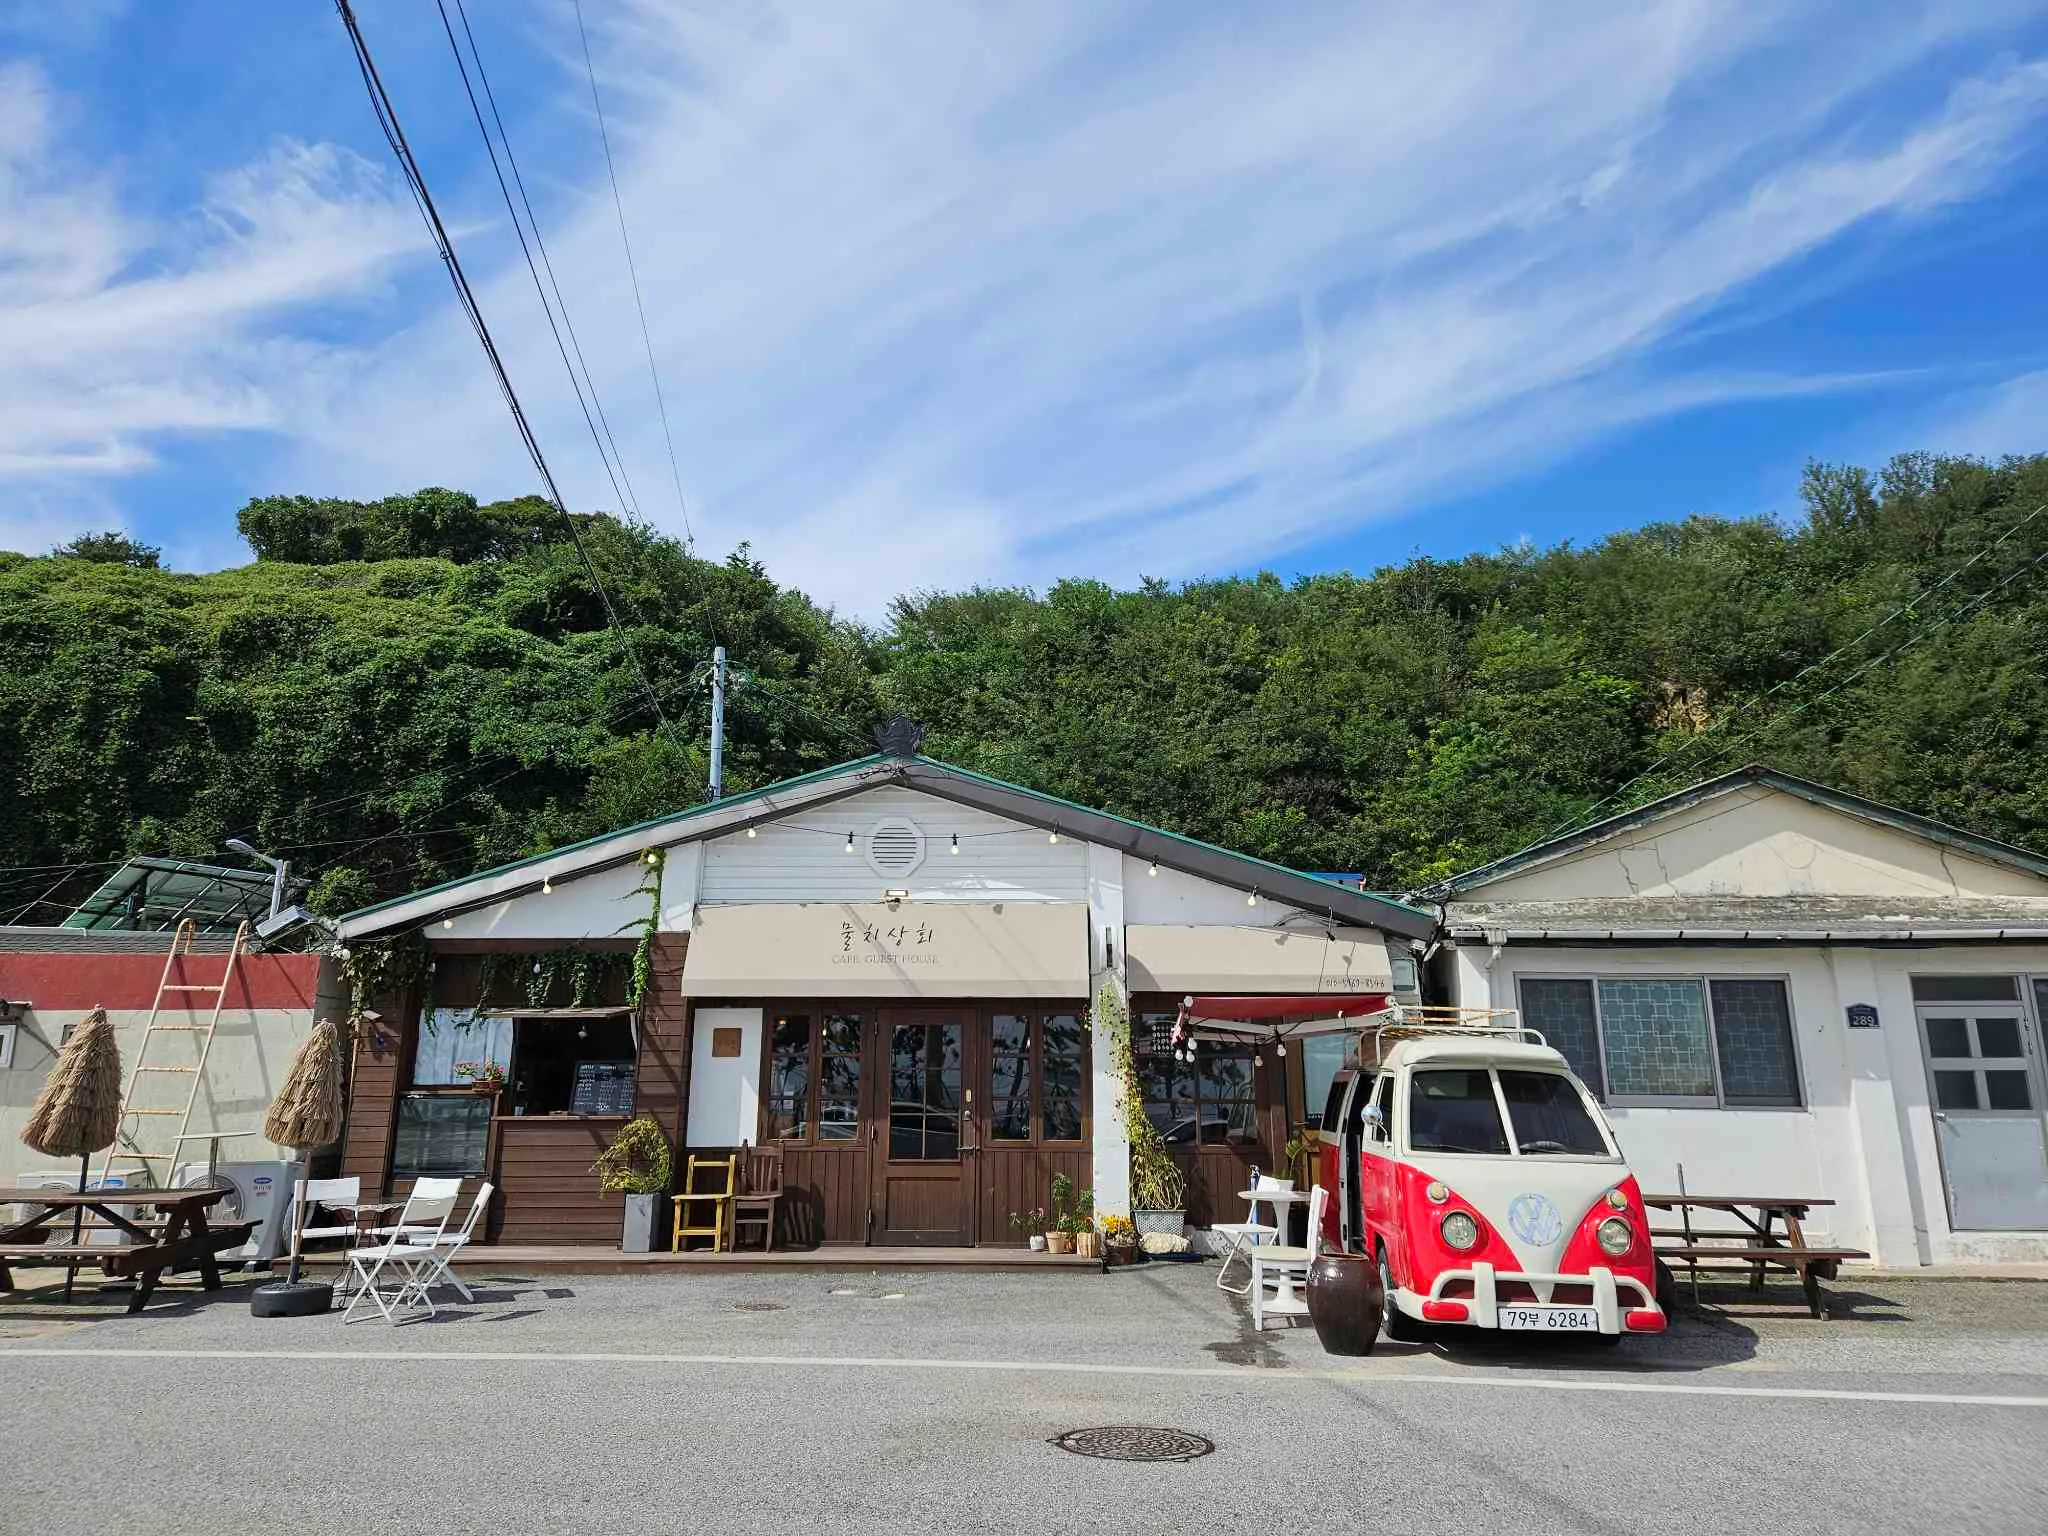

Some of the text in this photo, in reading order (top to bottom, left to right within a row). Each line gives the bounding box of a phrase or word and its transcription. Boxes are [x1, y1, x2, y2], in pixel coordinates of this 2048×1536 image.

[840, 921, 933, 951] 물치상회
[865, 955, 897, 964] GUEST
[902, 955, 940, 964] HOUSE
[1852, 1015, 1874, 1026] 289
[1507, 1311, 1589, 1328] 79부 6284
